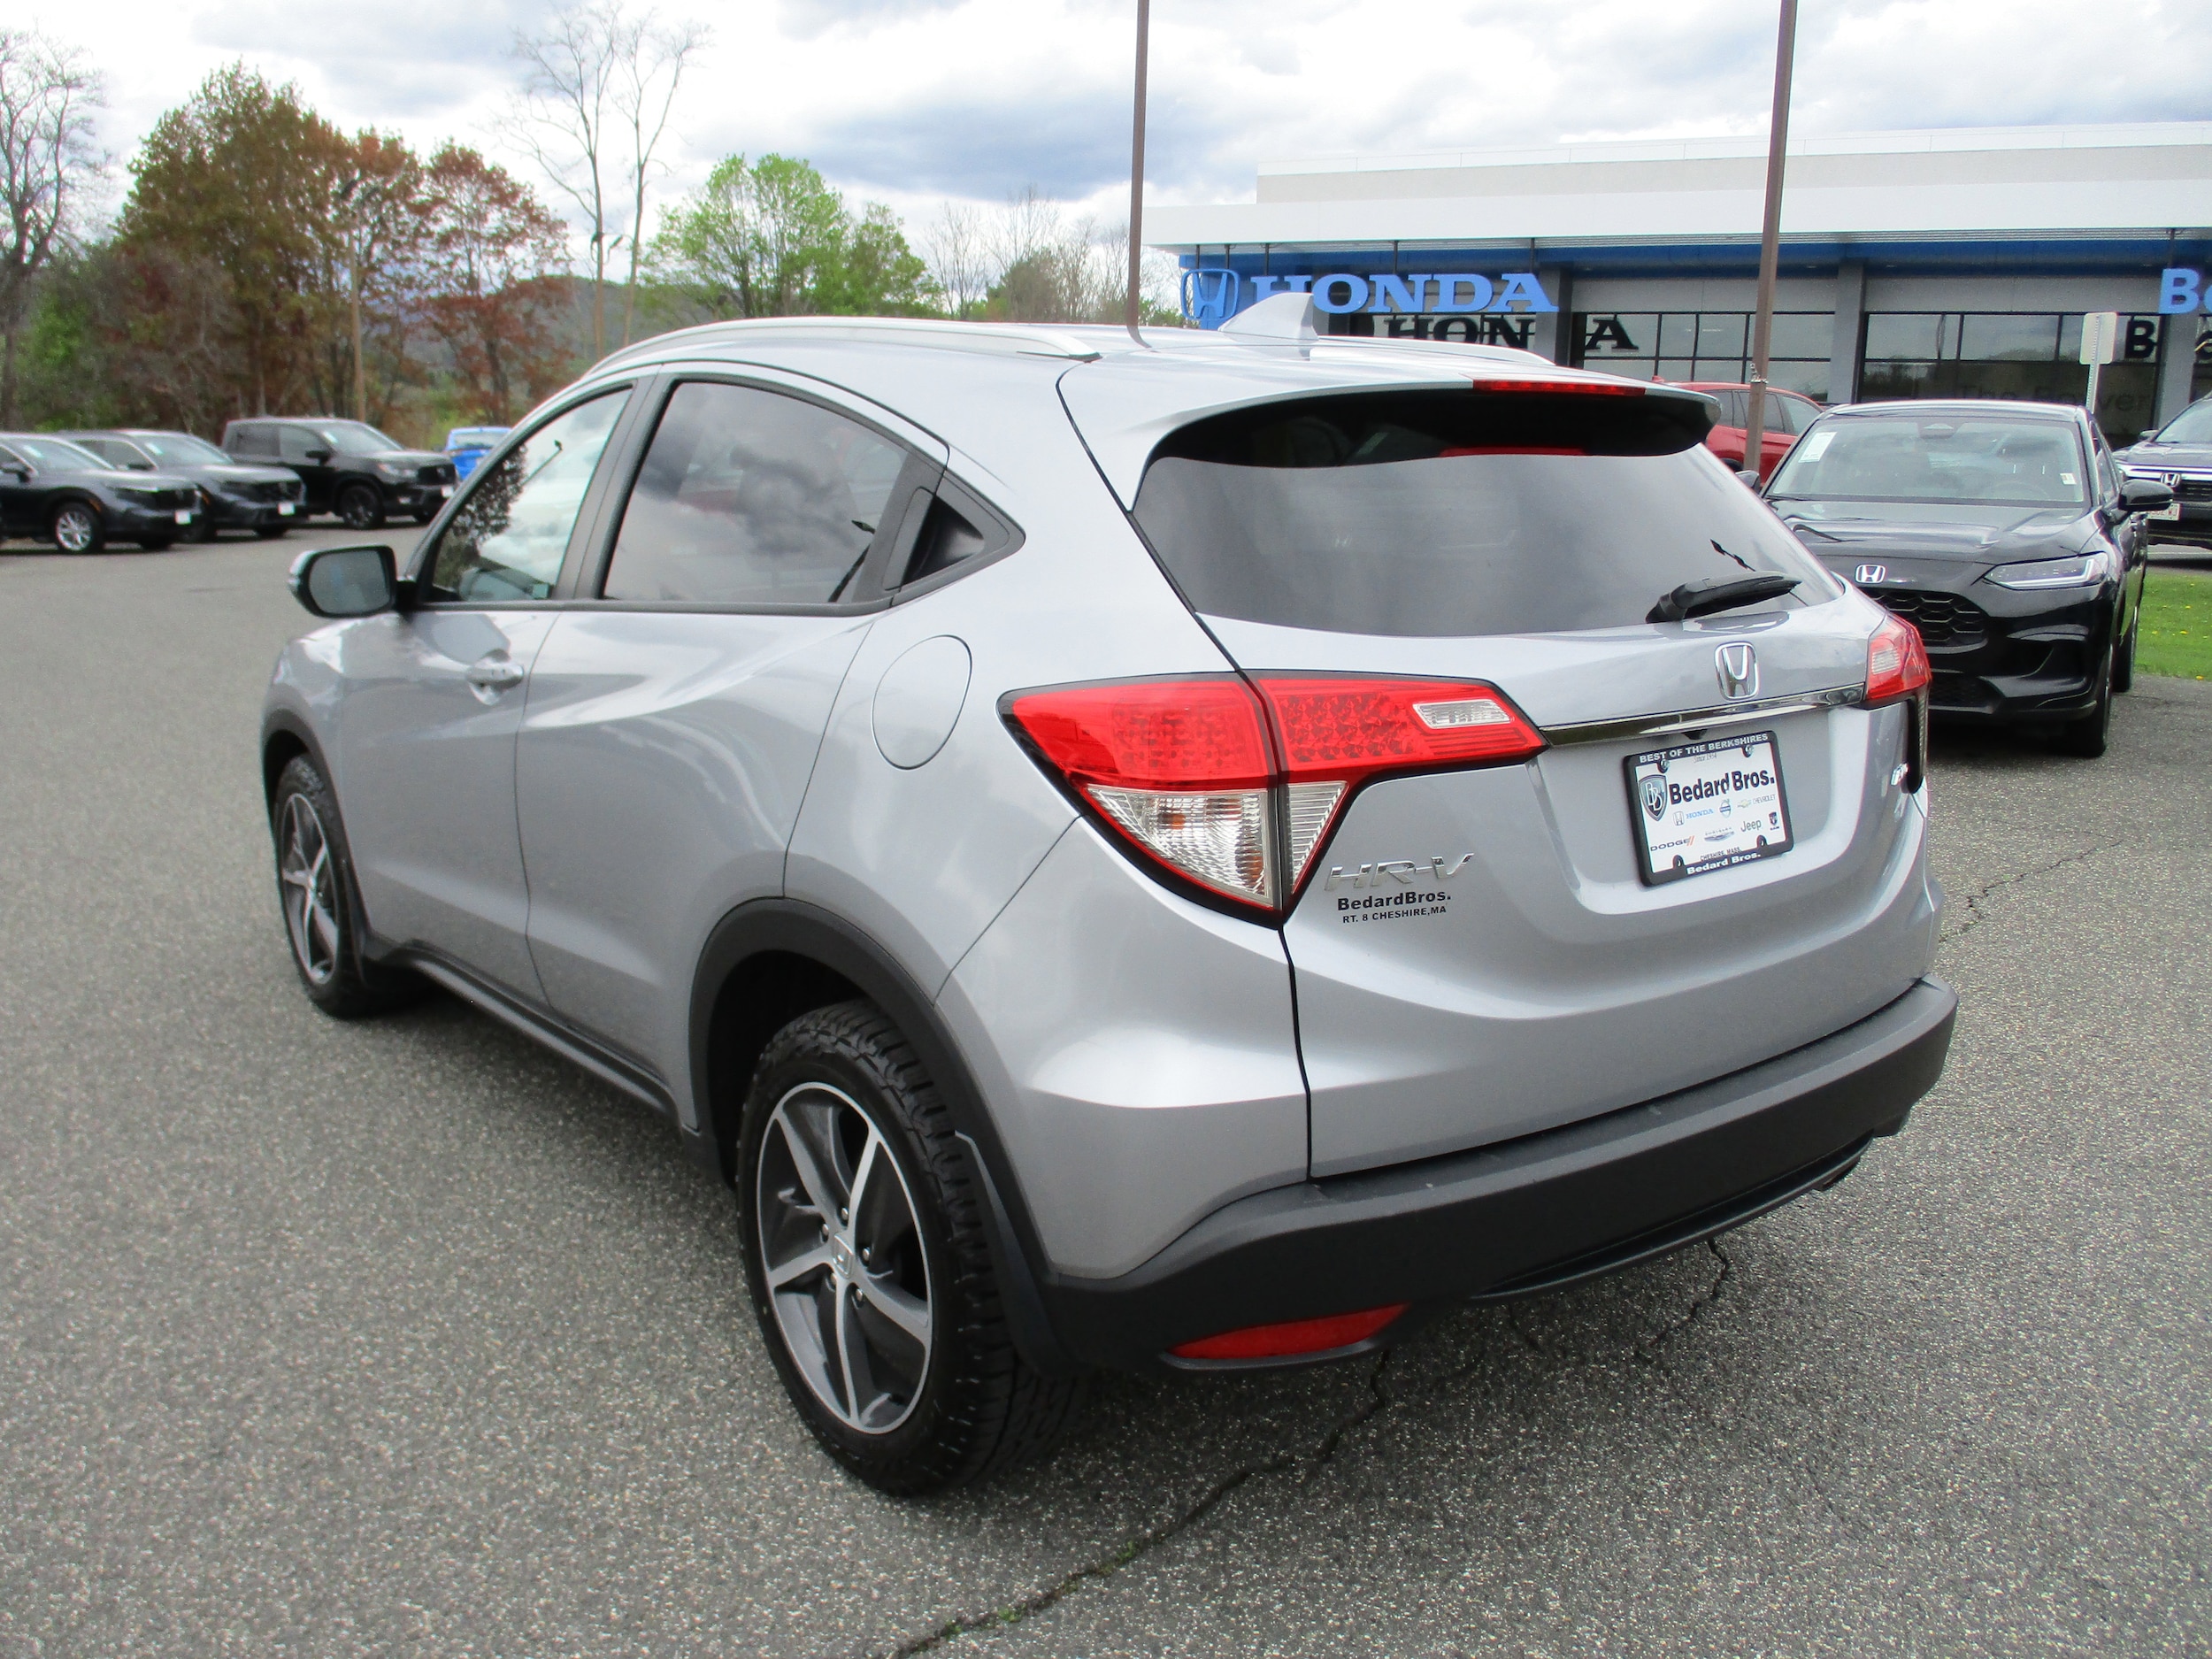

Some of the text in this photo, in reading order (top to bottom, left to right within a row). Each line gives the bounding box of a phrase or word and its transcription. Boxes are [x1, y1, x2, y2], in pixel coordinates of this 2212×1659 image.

[2159, 268, 2212, 314] B
[1640, 733, 1769, 763] BEST OF THE BERKSHIRES
[1669, 770, 1775, 805] Bedard Bros.
[1686, 809, 1714, 819] HONDA
[1740, 819, 1762, 832] Jeep
[1650, 838, 1690, 851] DODGE
[1325, 853, 1475, 891] HR-V
[1686, 852, 1761, 874] Bedard Bros.
[1343, 914, 1358, 923] RT.
[1363, 912, 1369, 921] 8
